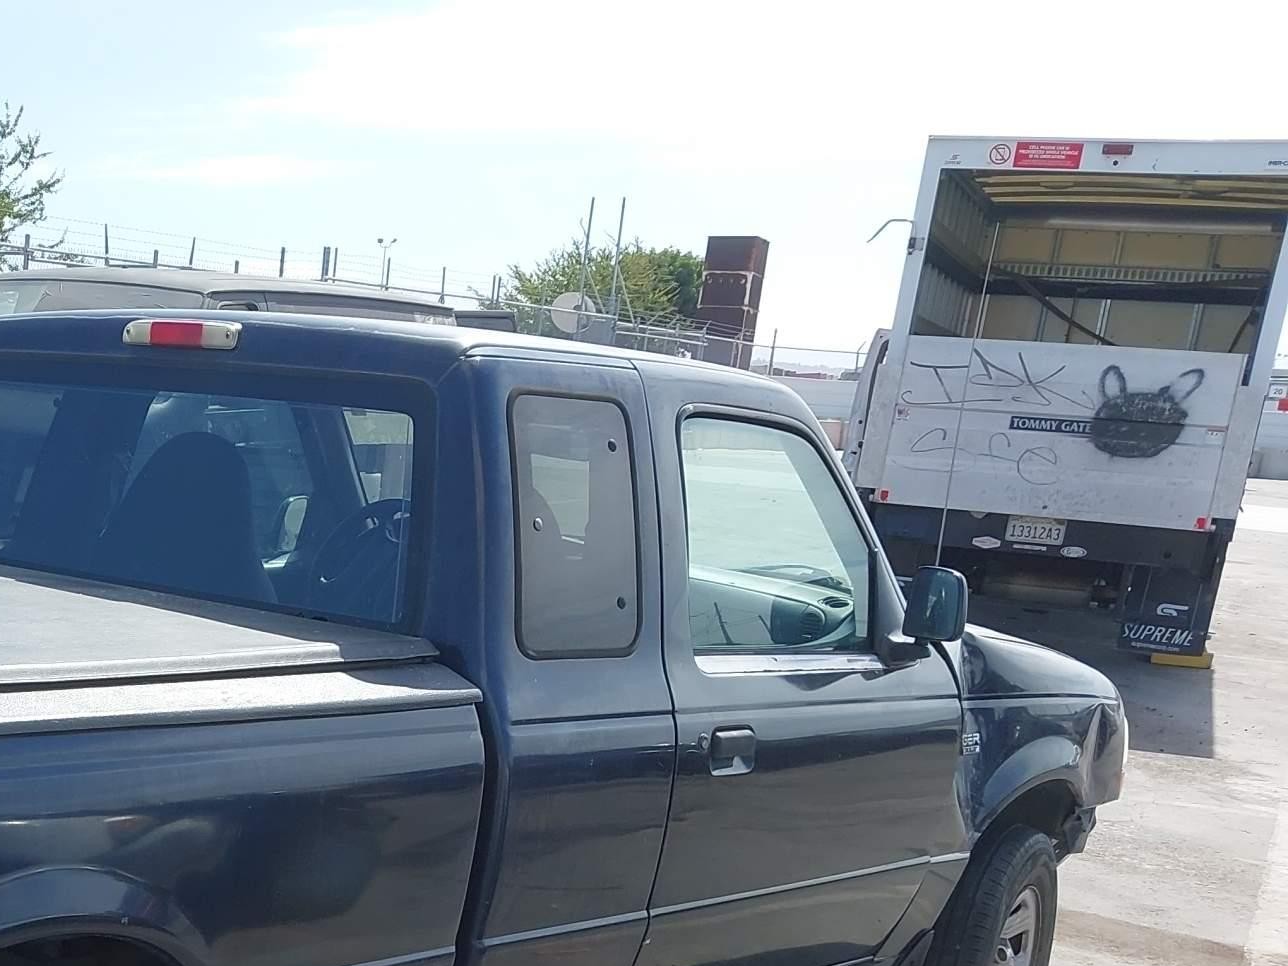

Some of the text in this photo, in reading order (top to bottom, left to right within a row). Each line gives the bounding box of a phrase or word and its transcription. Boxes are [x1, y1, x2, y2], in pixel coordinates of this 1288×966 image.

[1013, 418, 1093, 433] TOMMY GATE
[1010, 524, 1061, 541] 13312A3
[1123, 624, 1193, 646] SUPREME
